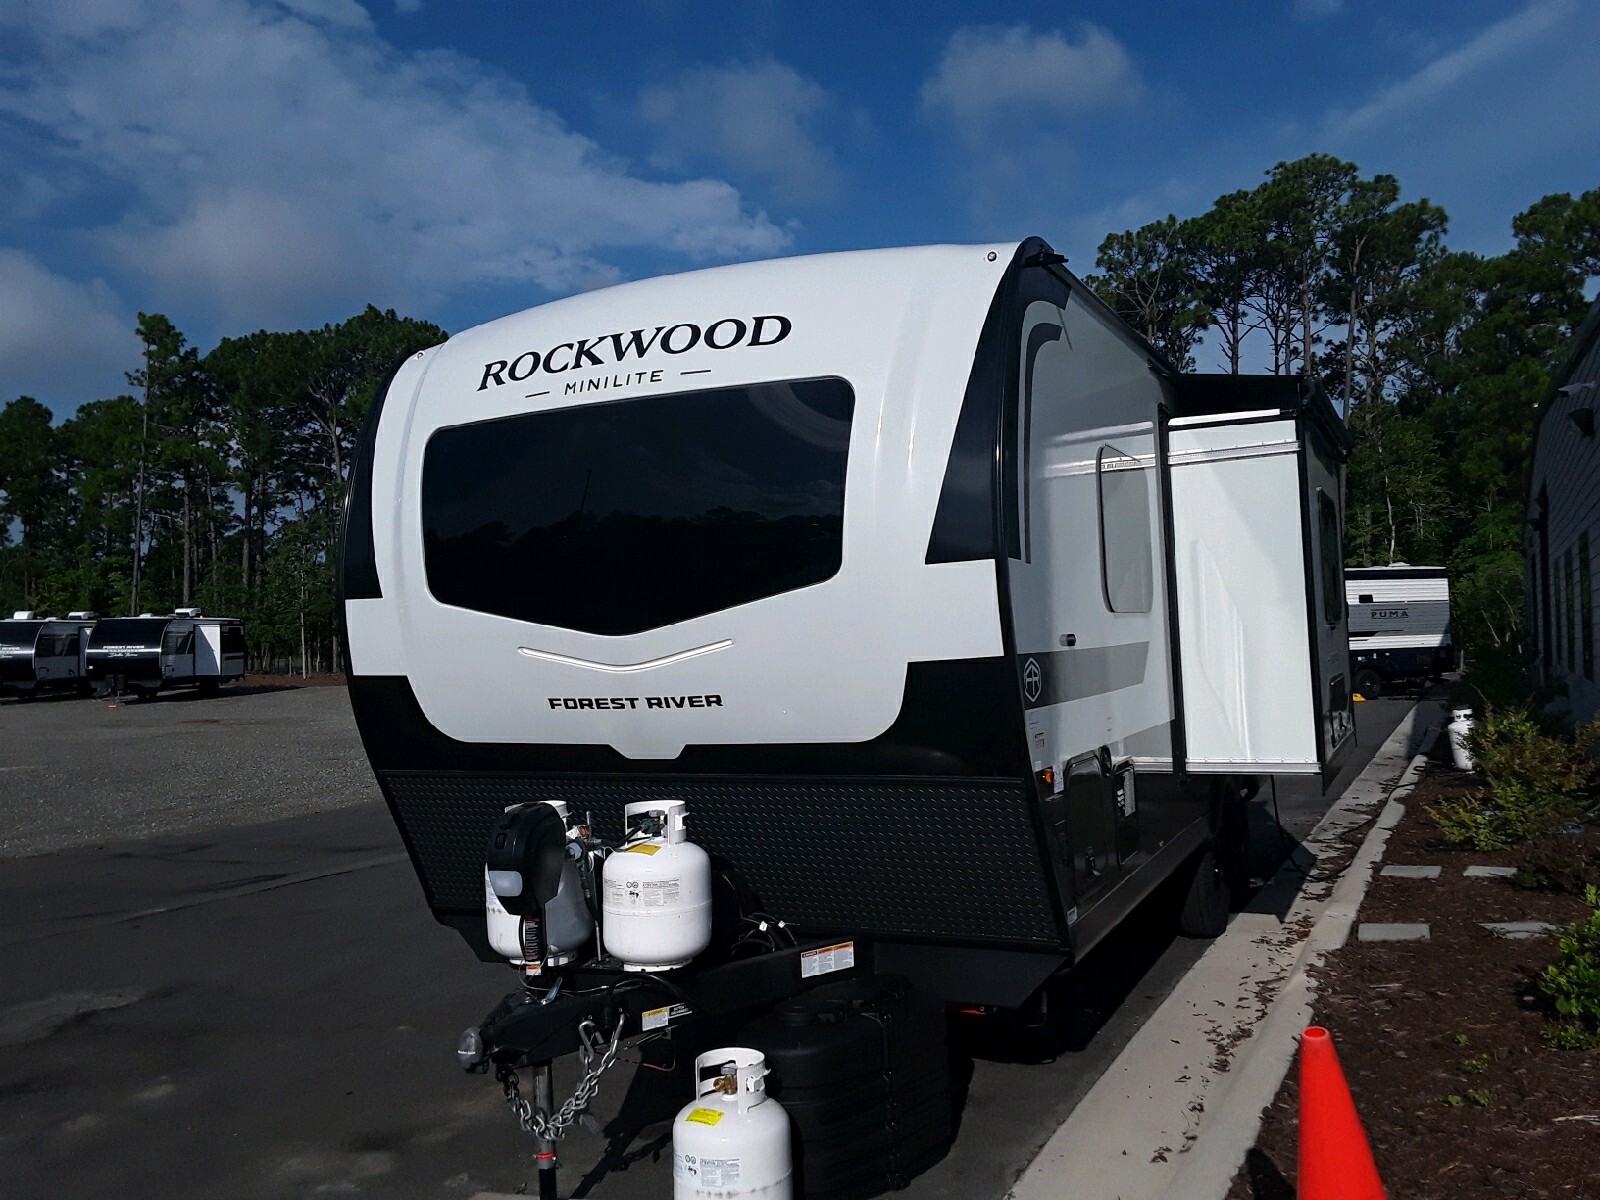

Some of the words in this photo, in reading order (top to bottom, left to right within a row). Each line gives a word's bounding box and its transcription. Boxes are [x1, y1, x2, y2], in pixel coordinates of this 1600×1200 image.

[476, 315, 792, 392] ROCKWOOD
[564, 370, 664, 396] MINILITE
[1371, 610, 1409, 618] PUMA
[548, 697, 640, 710] FOREST
[645, 694, 724, 709] RIVER
